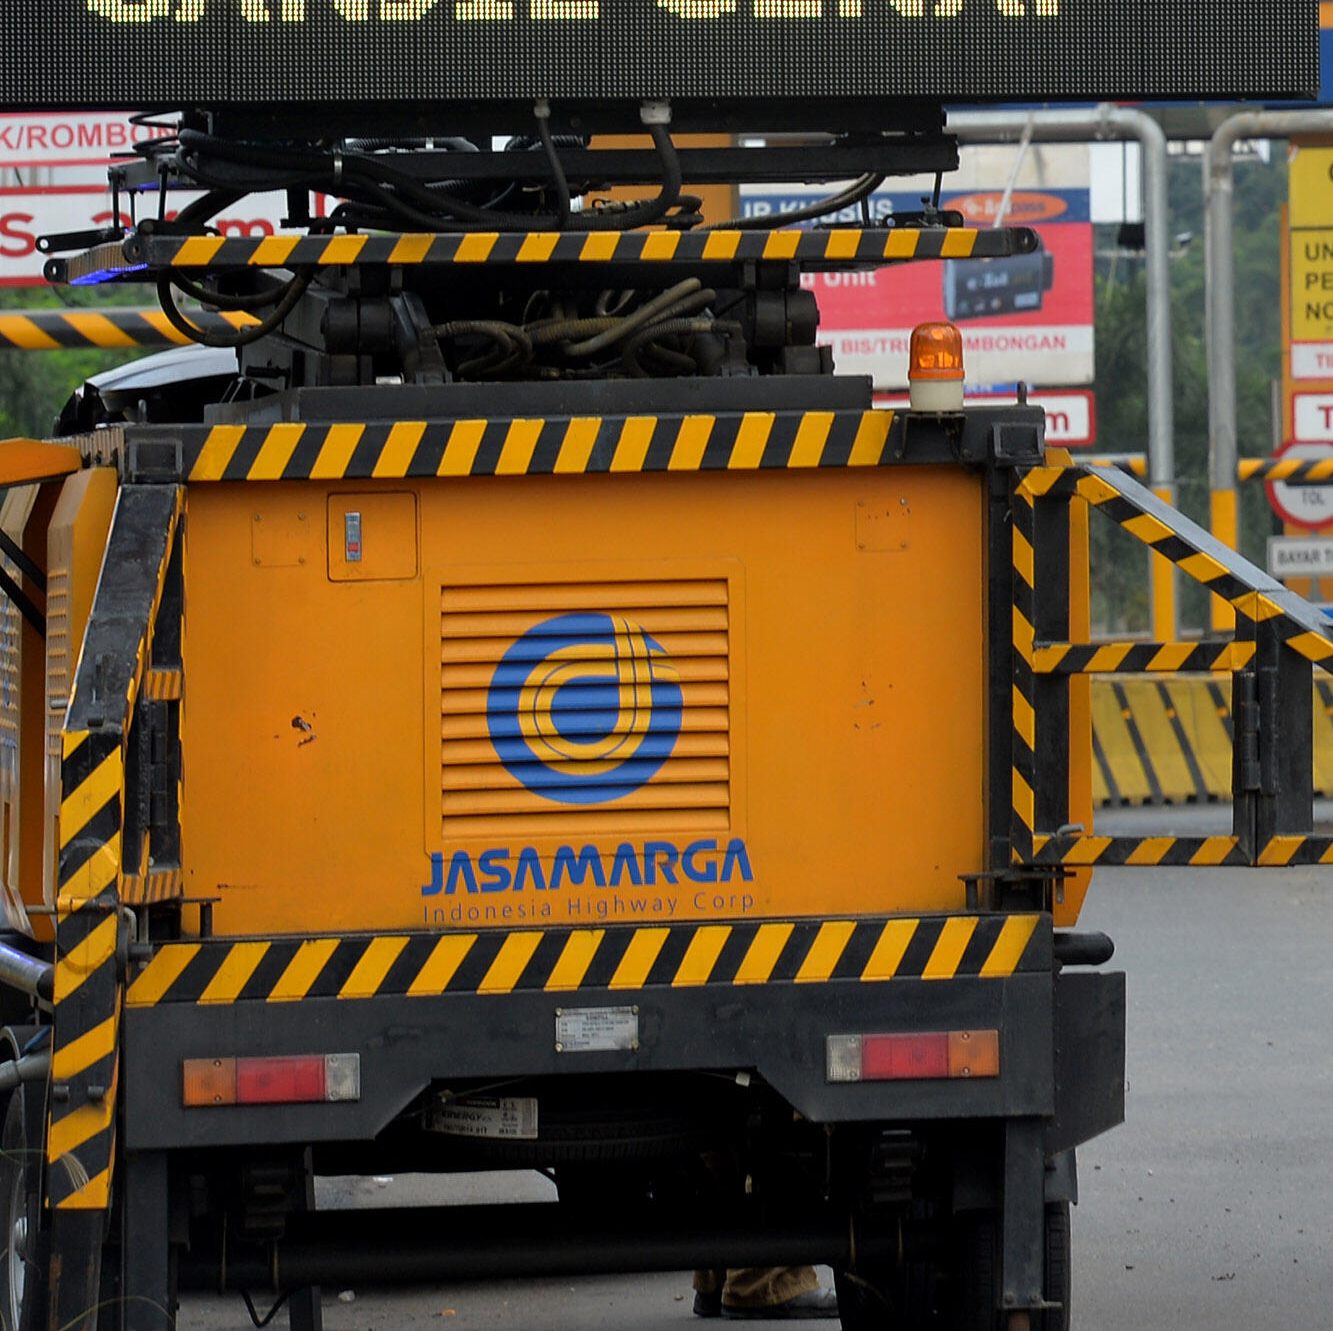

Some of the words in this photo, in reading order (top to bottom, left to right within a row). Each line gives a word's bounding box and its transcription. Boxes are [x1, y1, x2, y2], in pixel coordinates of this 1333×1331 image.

[1302, 489, 1326, 506] TOL
[1277, 550, 1321, 566] BAYAR
[421, 837, 754, 897] JASAMARGA
[423, 898, 553, 924] Indonesia
[566, 893, 679, 919] Highway
[693, 889, 756, 915] Corp
